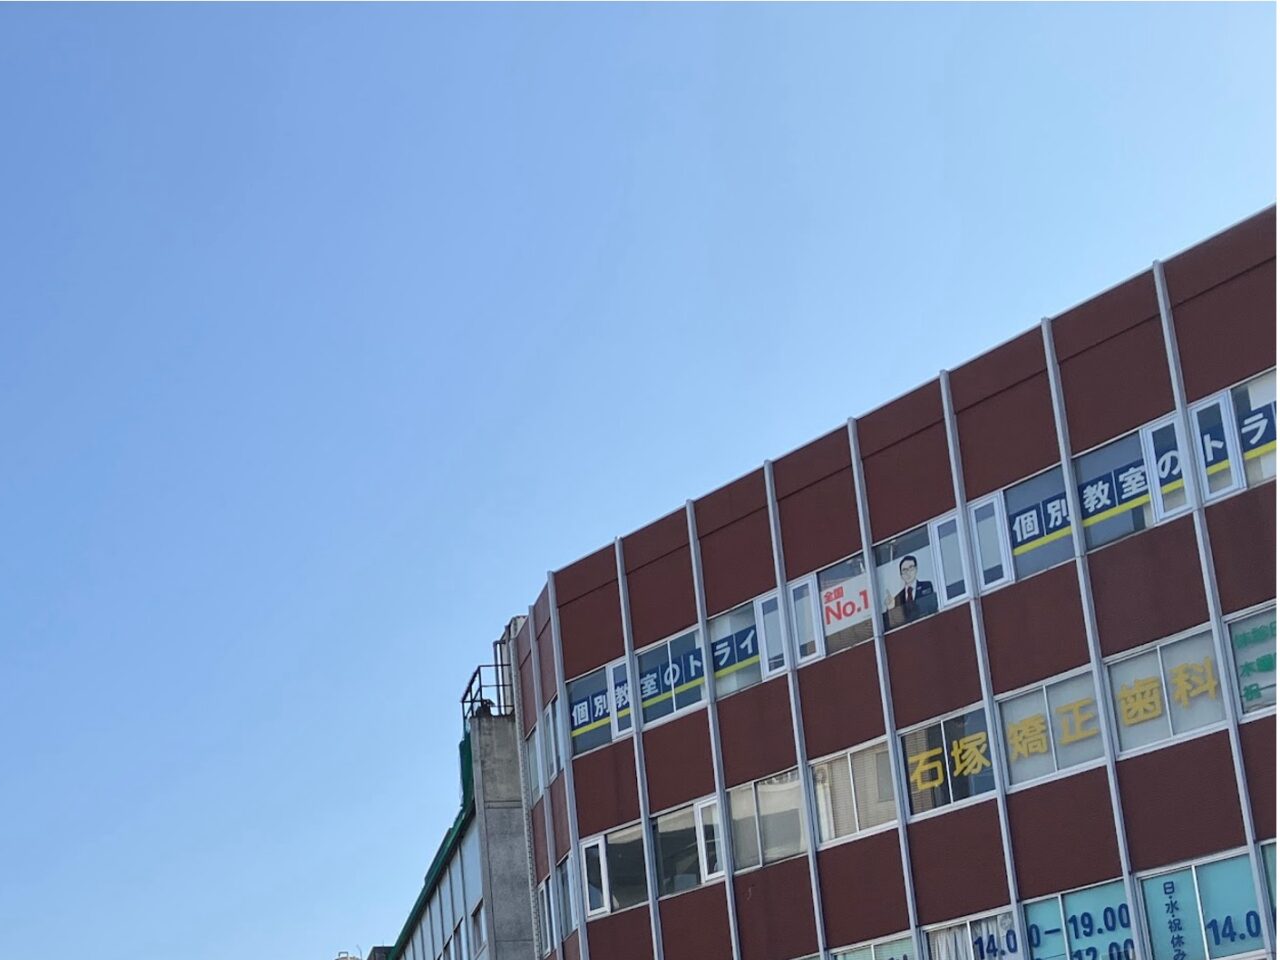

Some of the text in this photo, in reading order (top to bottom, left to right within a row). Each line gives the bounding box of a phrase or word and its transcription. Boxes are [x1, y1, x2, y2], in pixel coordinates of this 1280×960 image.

[824, 586, 844, 603] 全国
[825, 590, 870, 625] No.1
[907, 657, 1218, 790] 石塚矯正歯科
